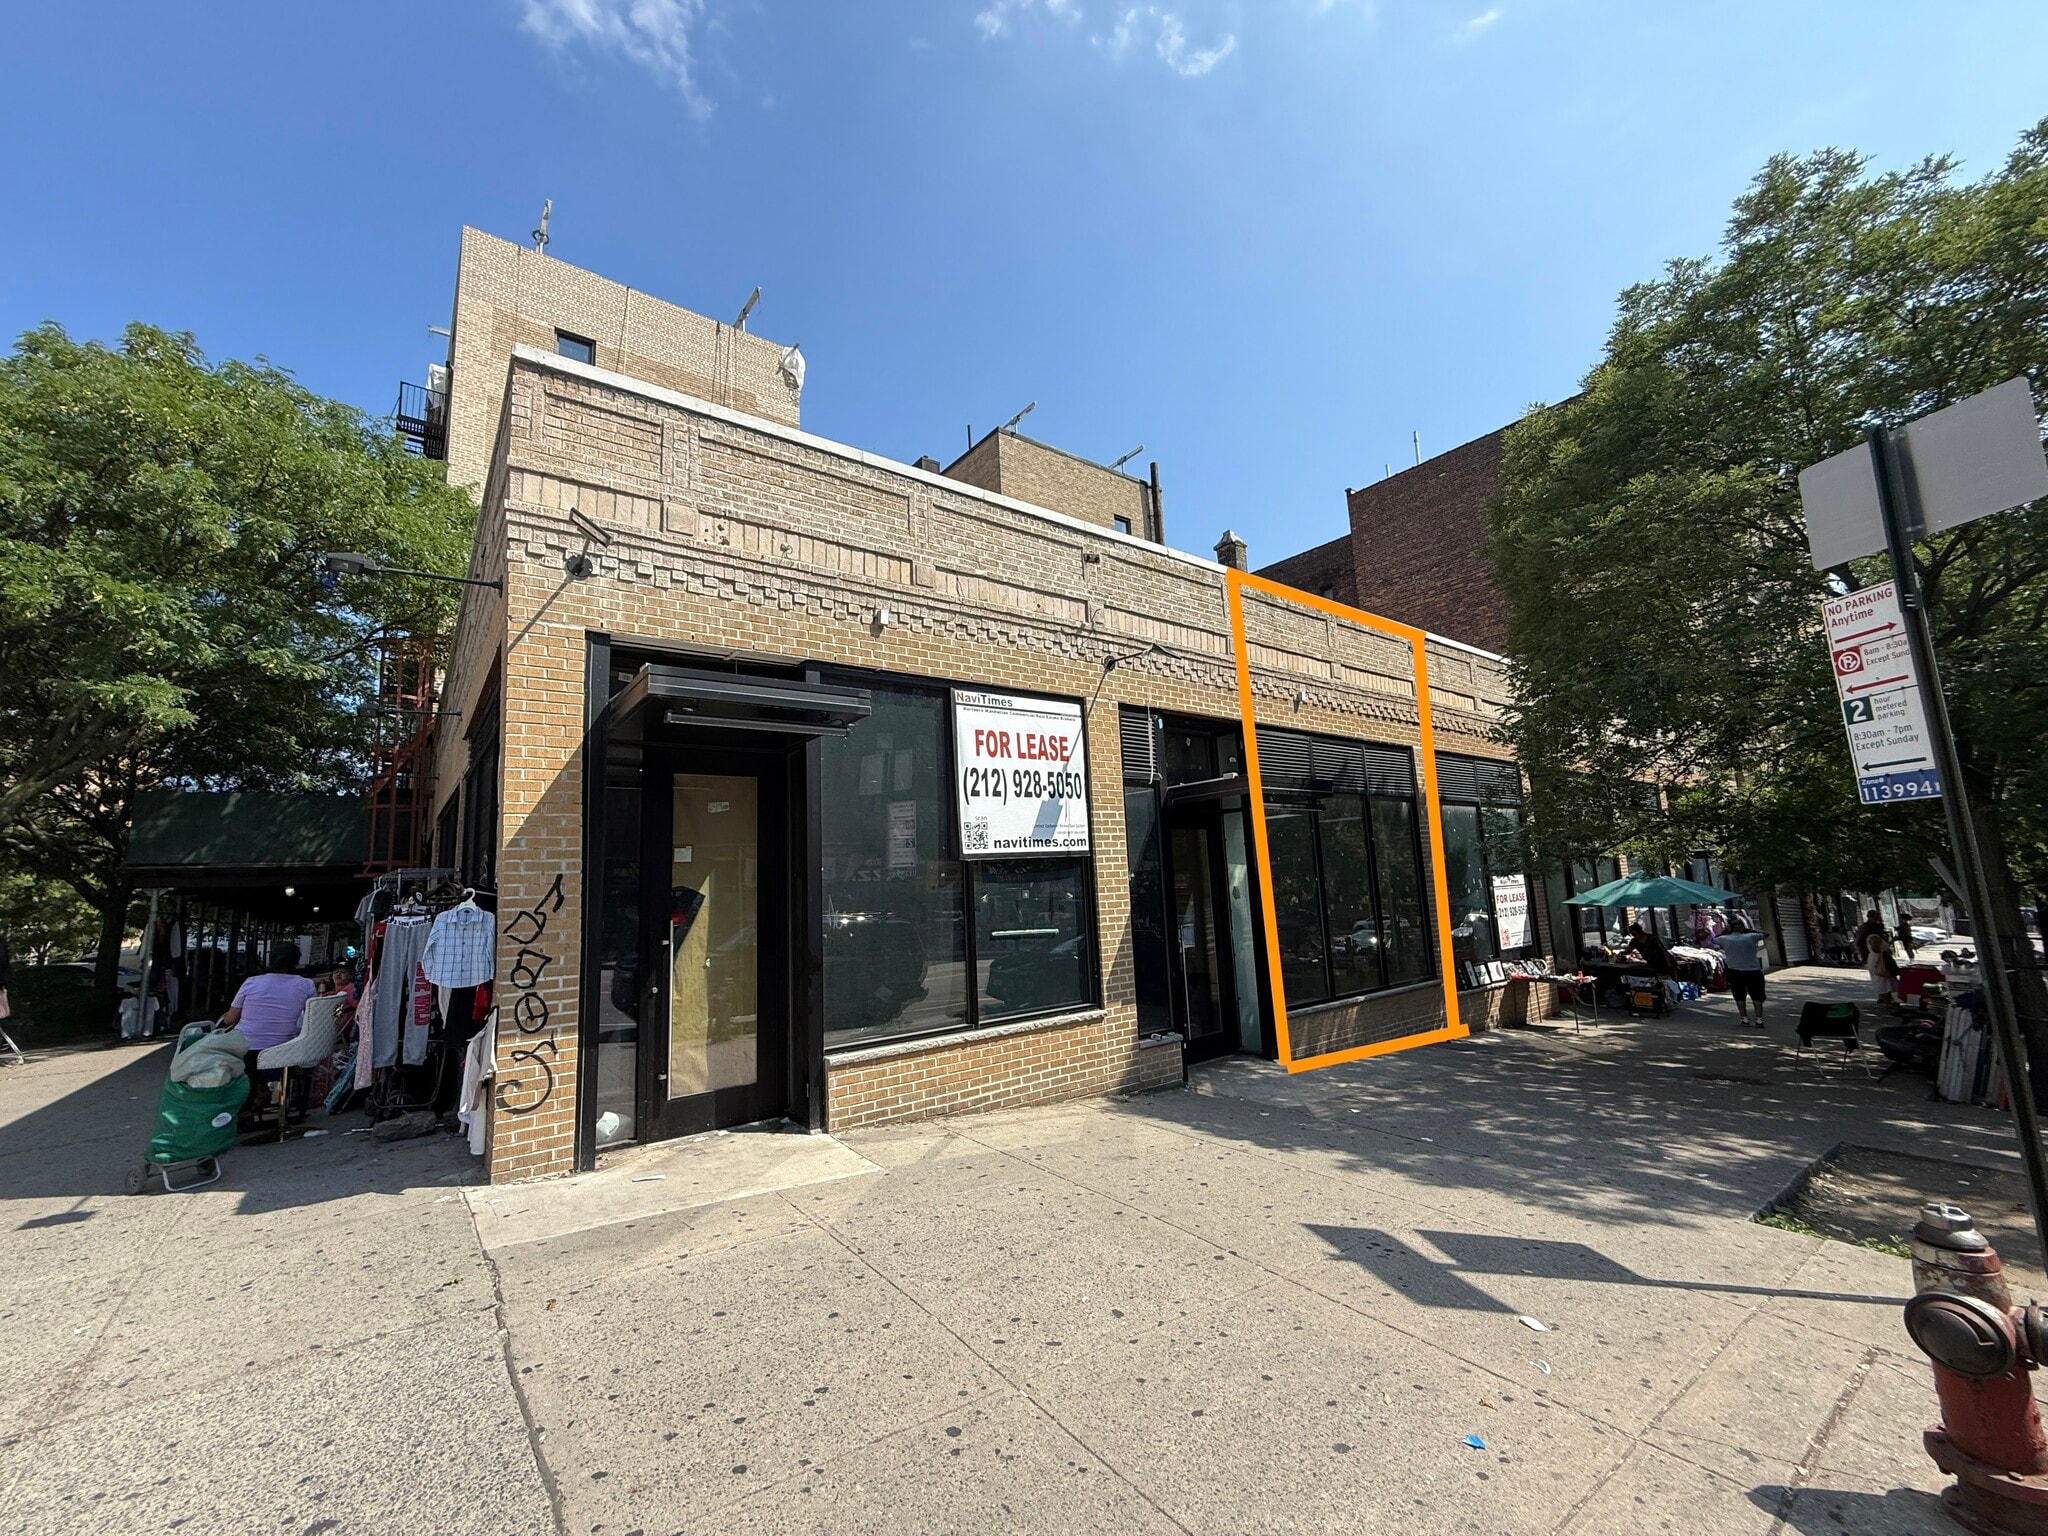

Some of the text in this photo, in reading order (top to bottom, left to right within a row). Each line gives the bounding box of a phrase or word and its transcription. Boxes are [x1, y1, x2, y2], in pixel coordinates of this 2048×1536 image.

[1827, 587, 1893, 617] NO PARKING
[1830, 607, 1874, 629] Anytime
[1886, 639, 1907, 650] 8:30a
[1866, 648, 1910, 666] Except Sund
[955, 691, 1013, 707] NaviTimes
[1874, 695, 1891, 705] hour
[1875, 699, 1908, 713] metered
[1851, 700, 1867, 723] 2
[1877, 709, 1906, 721] parking
[1853, 727, 1885, 741] 8:30am
[1893, 723, 1913, 736] 7pm
[974, 729, 1070, 762] FOR LEASE
[1855, 733, 1920, 752] Except Sunday
[963, 766, 1082, 806] (212) 928-5050
[993, 836, 1088, 850] navitimes.com
[1496, 892, 1526, 904] FOR LEASE
